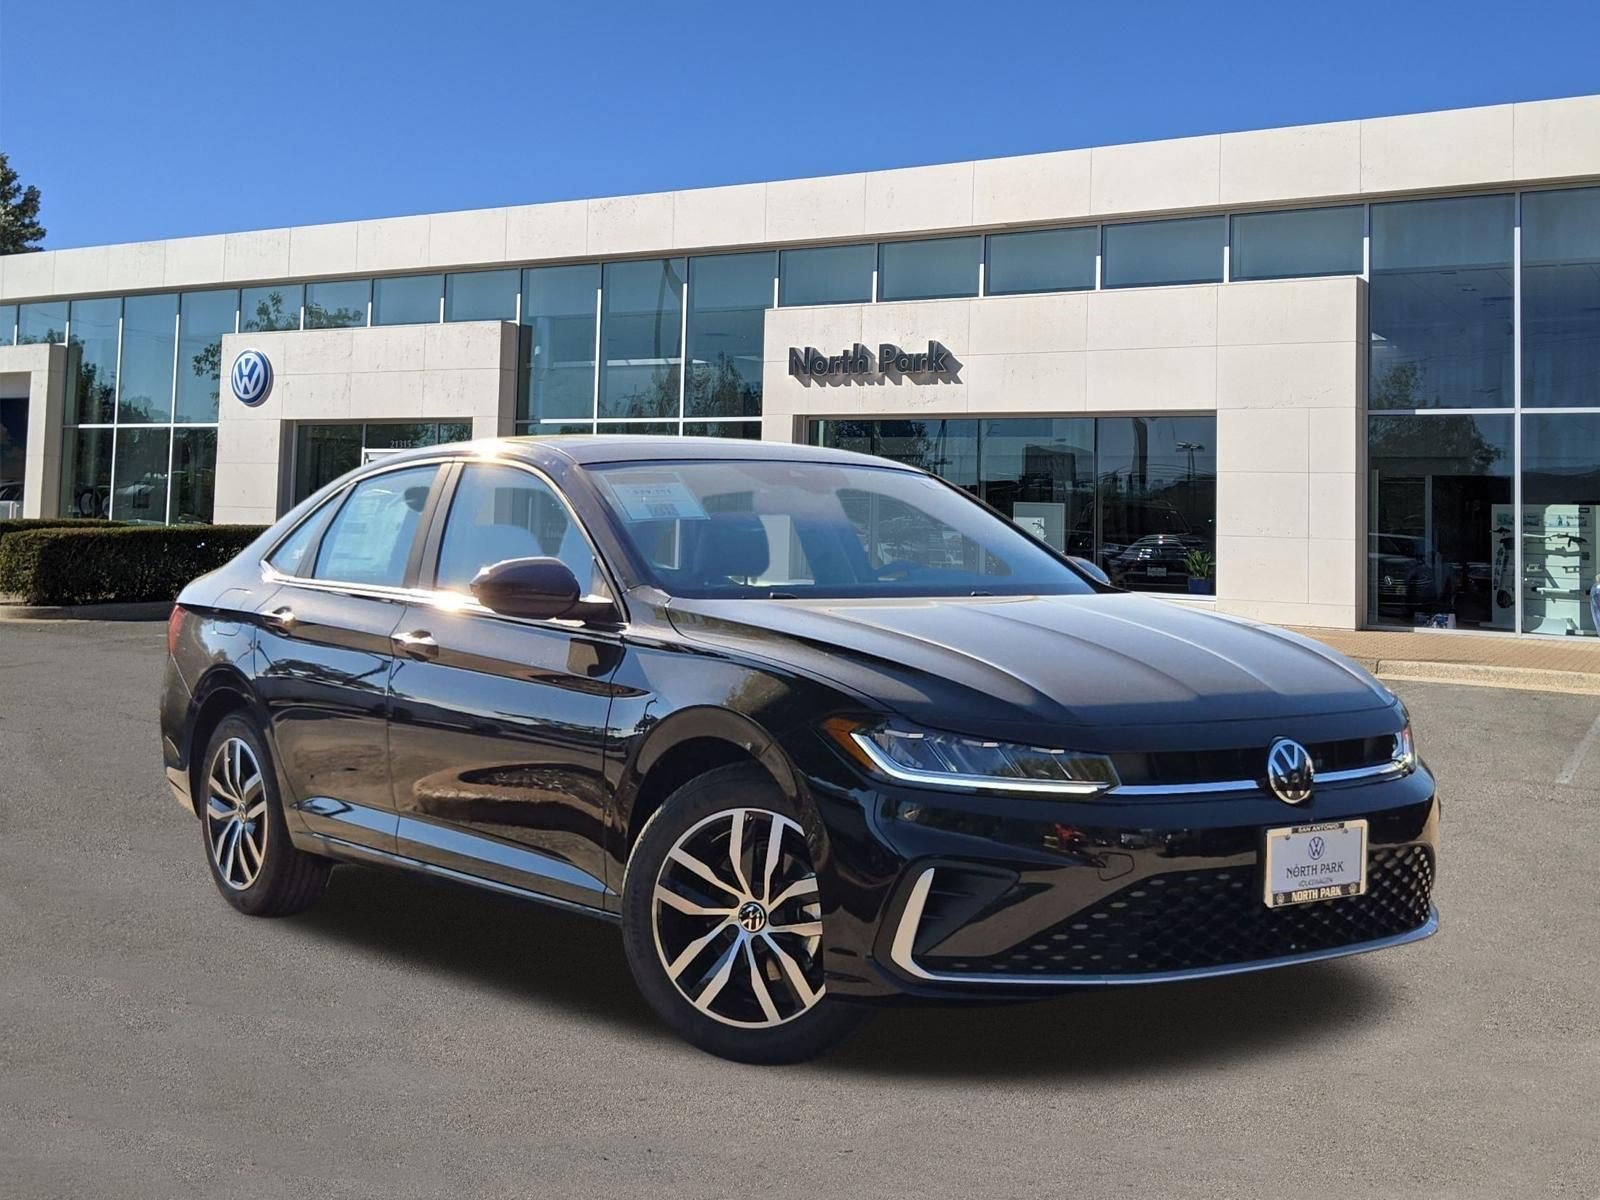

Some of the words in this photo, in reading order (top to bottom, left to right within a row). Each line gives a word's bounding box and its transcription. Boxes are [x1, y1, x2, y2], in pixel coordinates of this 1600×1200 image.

[788, 342, 871, 376] North
[878, 340, 947, 374] Park
[1286, 863, 1318, 879] NORTH
[1320, 860, 1344, 874] PARK
[1291, 887, 1319, 902] NORTH
[1320, 885, 1342, 898] PARK
